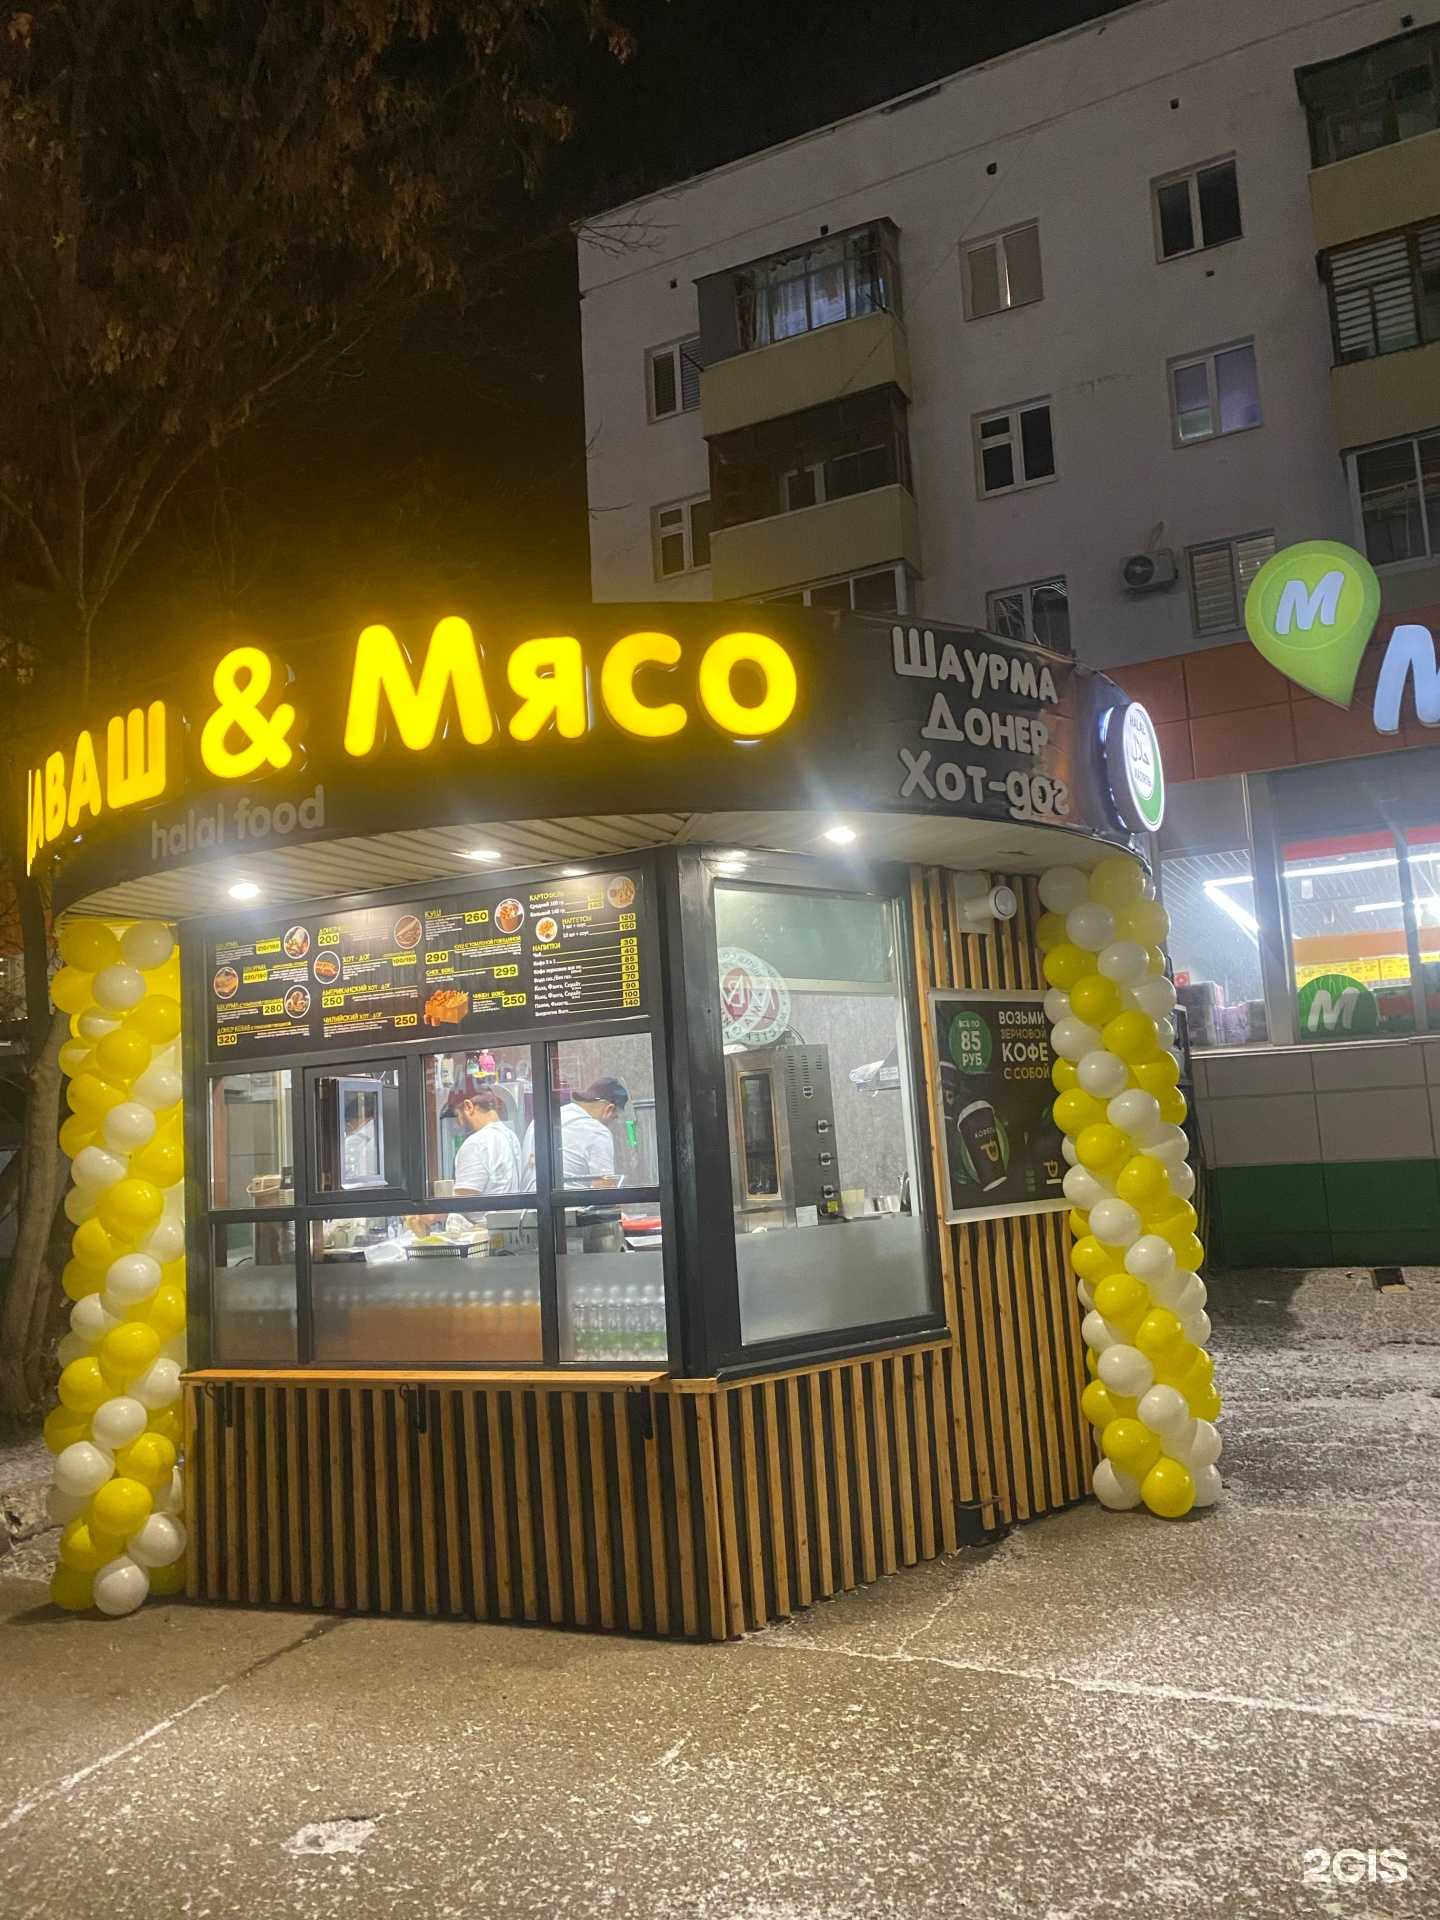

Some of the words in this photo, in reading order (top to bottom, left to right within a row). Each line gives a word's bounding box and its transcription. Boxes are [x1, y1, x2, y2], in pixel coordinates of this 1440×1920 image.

[893, 626, 1058, 704] ШАУРМА
[200, 646, 296, 779] &
[343, 615, 798, 757] Мясо
[921, 692, 1049, 755] ДОНЕР
[151, 803, 225, 860] halal
[232, 783, 325, 840] food
[466, 911, 487, 923] 260
[319, 934, 339, 944] 200
[426, 952, 448, 963] 290
[495, 966, 517, 977] 299
[624, 990, 638, 998] 100
[503, 995, 525, 1006] 250
[264, 1004, 282, 1014] 280
[395, 1015, 416, 1026] 250
[998, 1010, 1045, 1025] ВОЗЬМИ
[217, 1034, 237, 1045] 320
[960, 1031, 982, 1051] 85
[1001, 1042, 1049, 1063] КОФЕ
[1014, 1063, 1050, 1080] СОБОЙ
